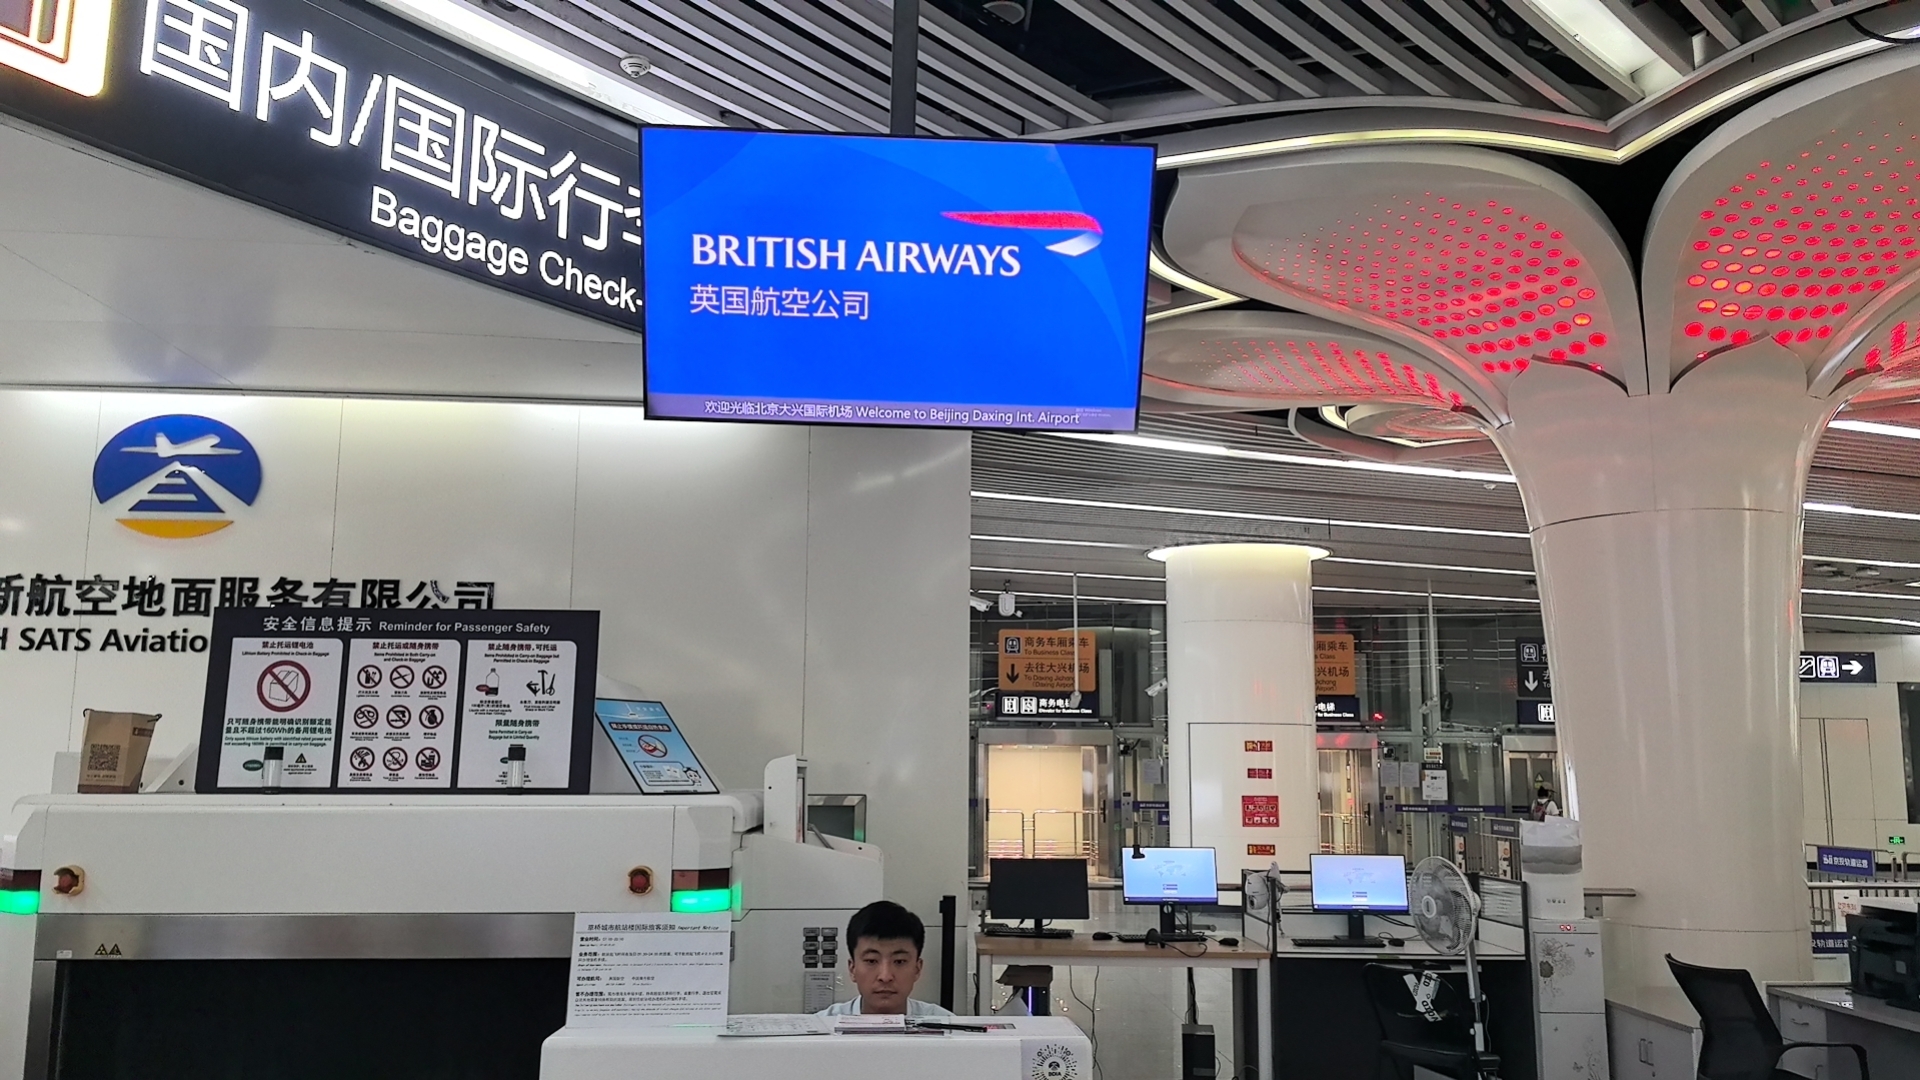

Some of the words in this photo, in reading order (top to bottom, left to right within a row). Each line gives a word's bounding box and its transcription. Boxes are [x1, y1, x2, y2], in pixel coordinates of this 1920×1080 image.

[371, 186, 528, 275] Baggage
[540, 251, 642, 312] Check-
[692, 234, 846, 270] BRITISH
[856, 241, 1021, 277] AIRWAYS
[690, 284, 869, 320] 英国航空公司
[704, 401, 853, 419] 欢迎光临北京大兴国际机场
[856, 406, 911, 419] Welcome
[914, 410, 926, 420] to
[929, 409, 969, 424] Beijing
[972, 410, 1013, 425] Daxing
[1016, 412, 1035, 423] Int.
[1038, 411, 1080, 426] Airport
[263, 616, 372, 632] 安全信息提示
[379, 621, 432, 631] Reminder
[436, 622, 451, 631] for
[455, 622, 512, 635] Passenger
[515, 622, 550, 635] Safety
[18, 628, 92, 651] SATS
[99, 628, 208, 652] Aviatio
[262, 641, 314, 649] 禁止托运锂电池
[373, 642, 439, 650] 禁止托运或随身携带
[1024, 636, 1089, 648] 商务车厢乘车
[1316, 641, 1348, 651] 厢乘车
[1024, 662, 1090, 674] 去往大兴机场
[1315, 666, 1349, 677] 兴机场
[1315, 702, 1335, 711] 电梯
